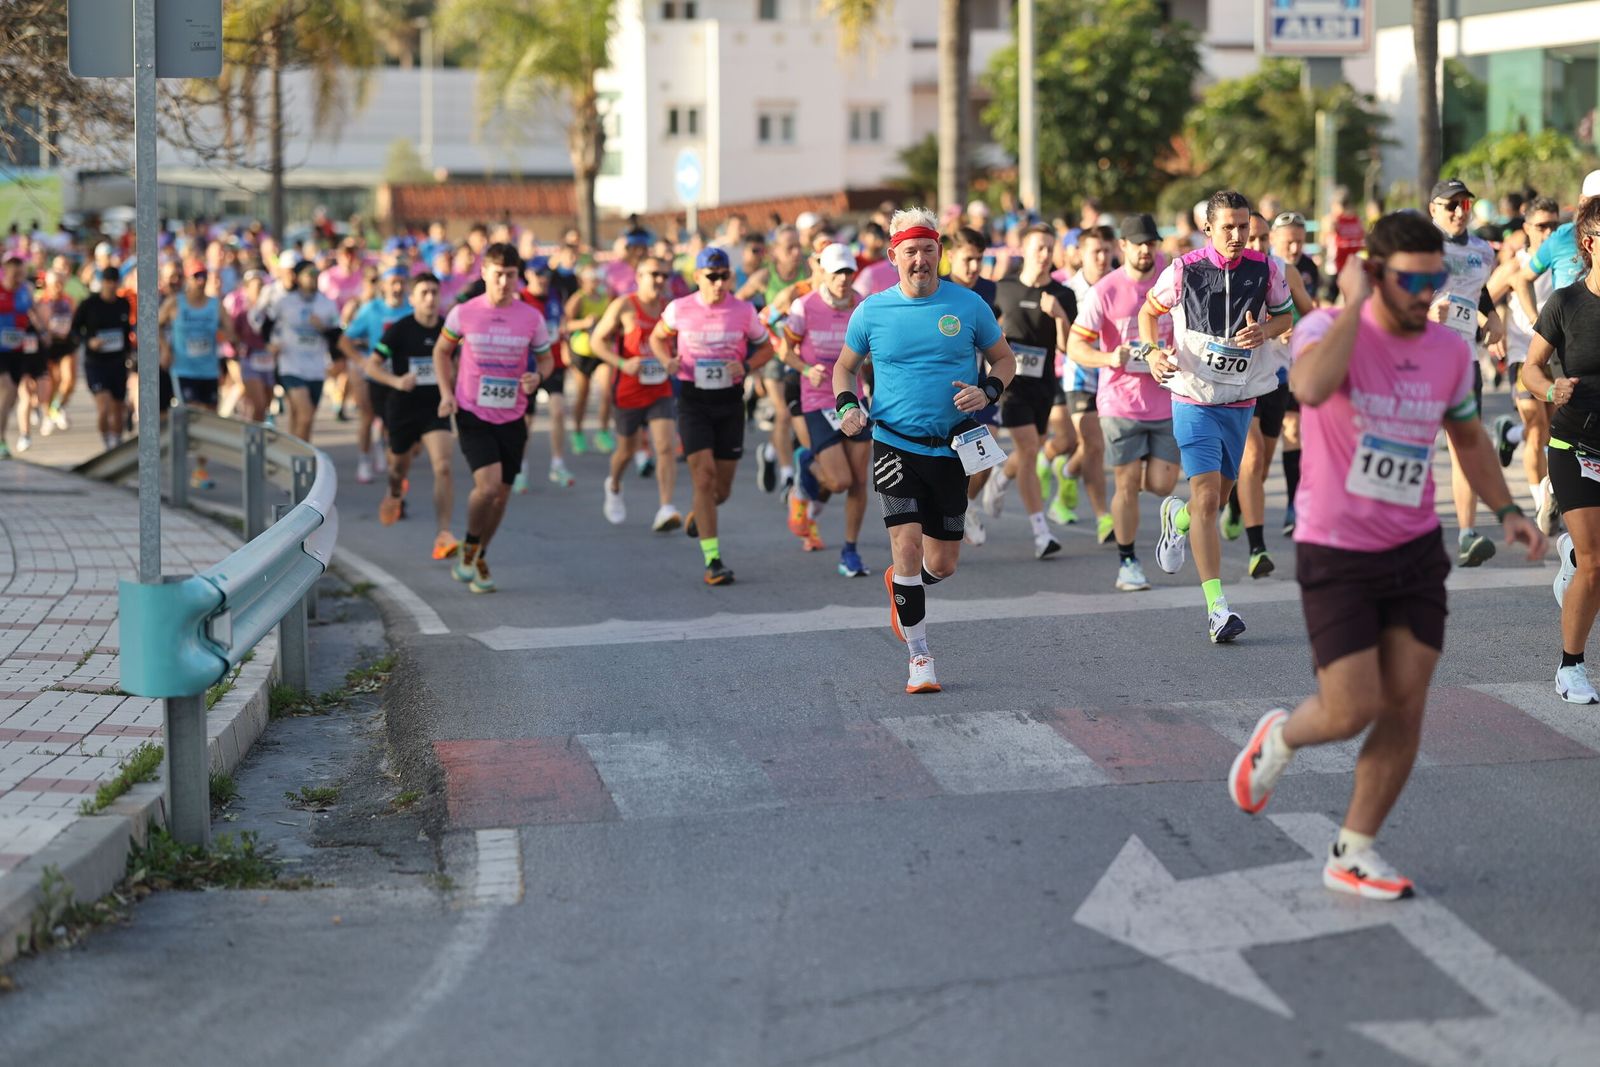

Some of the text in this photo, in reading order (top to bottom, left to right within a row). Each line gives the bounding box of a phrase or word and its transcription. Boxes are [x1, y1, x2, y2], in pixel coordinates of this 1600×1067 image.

[1455, 305, 1471, 321] 75
[1205, 352, 1248, 374] 1370
[705, 367, 723, 380] 23
[481, 385, 515, 399] 2456
[975, 439, 986, 457] 5
[1361, 451, 1424, 486] 1012
